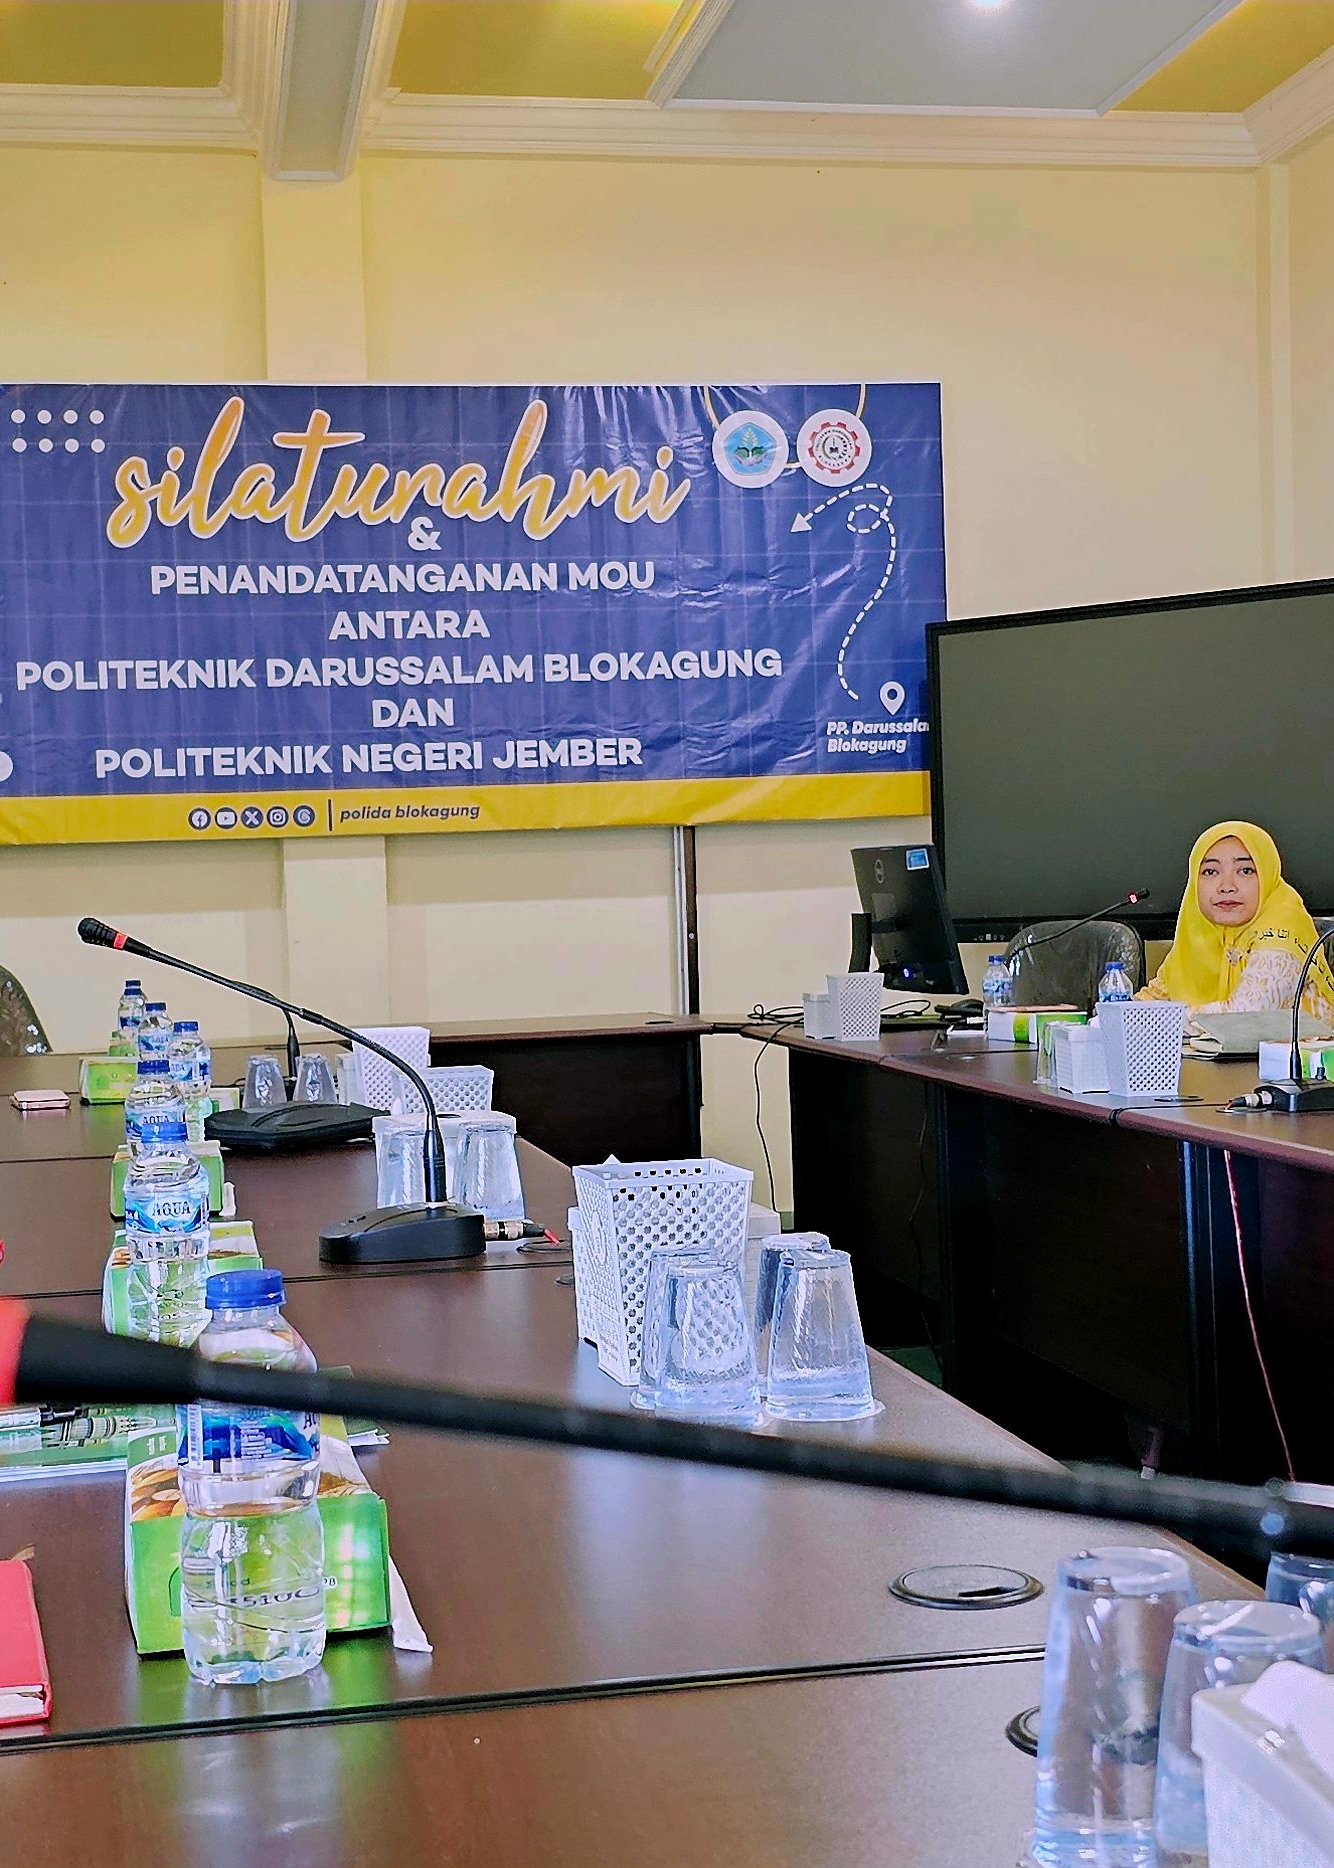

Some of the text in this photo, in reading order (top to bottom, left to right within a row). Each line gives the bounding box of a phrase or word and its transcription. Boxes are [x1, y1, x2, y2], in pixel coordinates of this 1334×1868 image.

[106, 396, 691, 549] silaturahmi
[407, 517, 442, 551] &
[151, 561, 655, 595] PENANDATANGANAN MOU
[328, 609, 491, 641] ANTARA
[16, 648, 783, 692] POLITEKNIK DARUSSALAM BLOKAGUNG
[372, 698, 455, 728] DAN
[827, 721, 849, 735] PP.
[95, 737, 644, 779] POLITEKNIK NEGERI JEMBER
[827, 738, 907, 754] Blokagung
[340, 804, 480, 823] polida blokagung
[152, 1200, 191, 1218] AQUA
